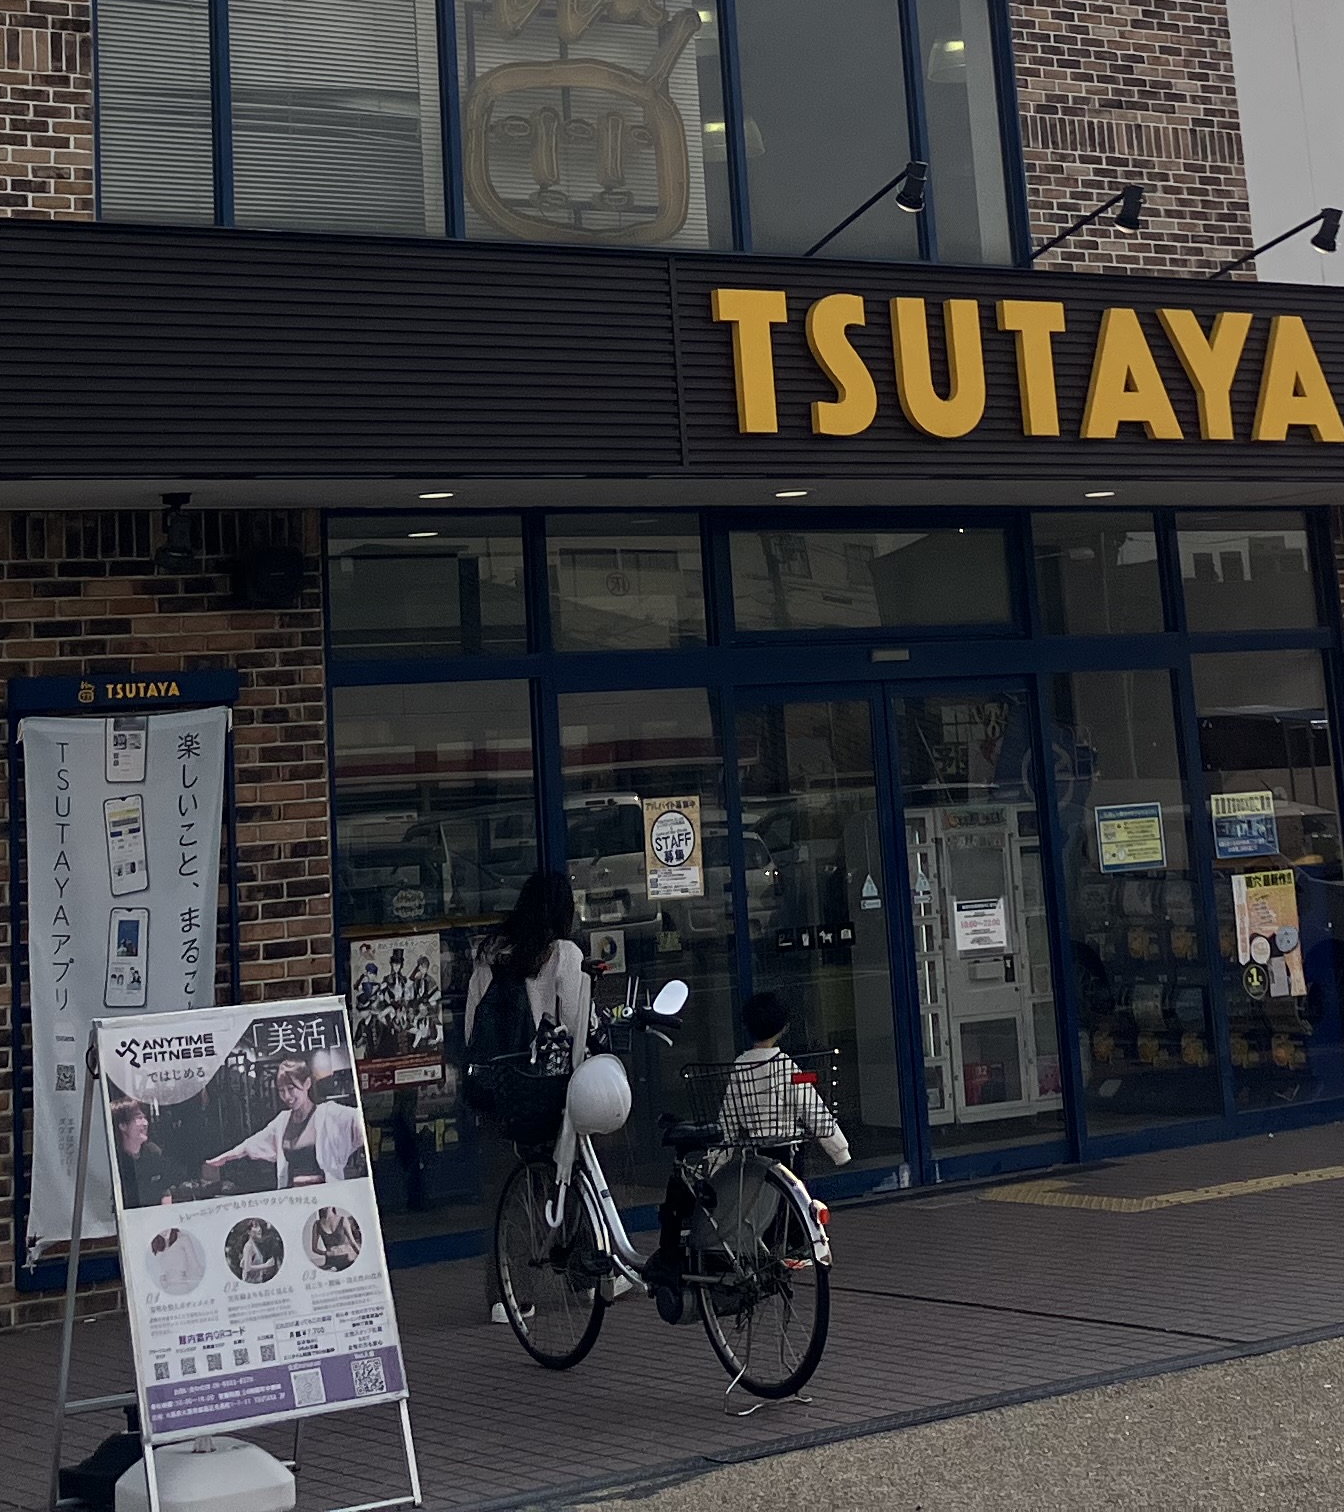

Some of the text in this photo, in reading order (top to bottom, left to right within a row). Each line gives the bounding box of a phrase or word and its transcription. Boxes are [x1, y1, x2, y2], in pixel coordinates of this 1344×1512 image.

[105, 681, 181, 699] TSUTAYA
[655, 832, 692, 852] STAFF
[51, 741, 74, 1012] TSUTAYAアプリ
[142, 1032, 214, 1052] ANYTIME
[250, 1017, 344, 1055] 「美活」
[142, 1043, 217, 1062] FITNESS
[146, 1066, 206, 1084] ではじめる
